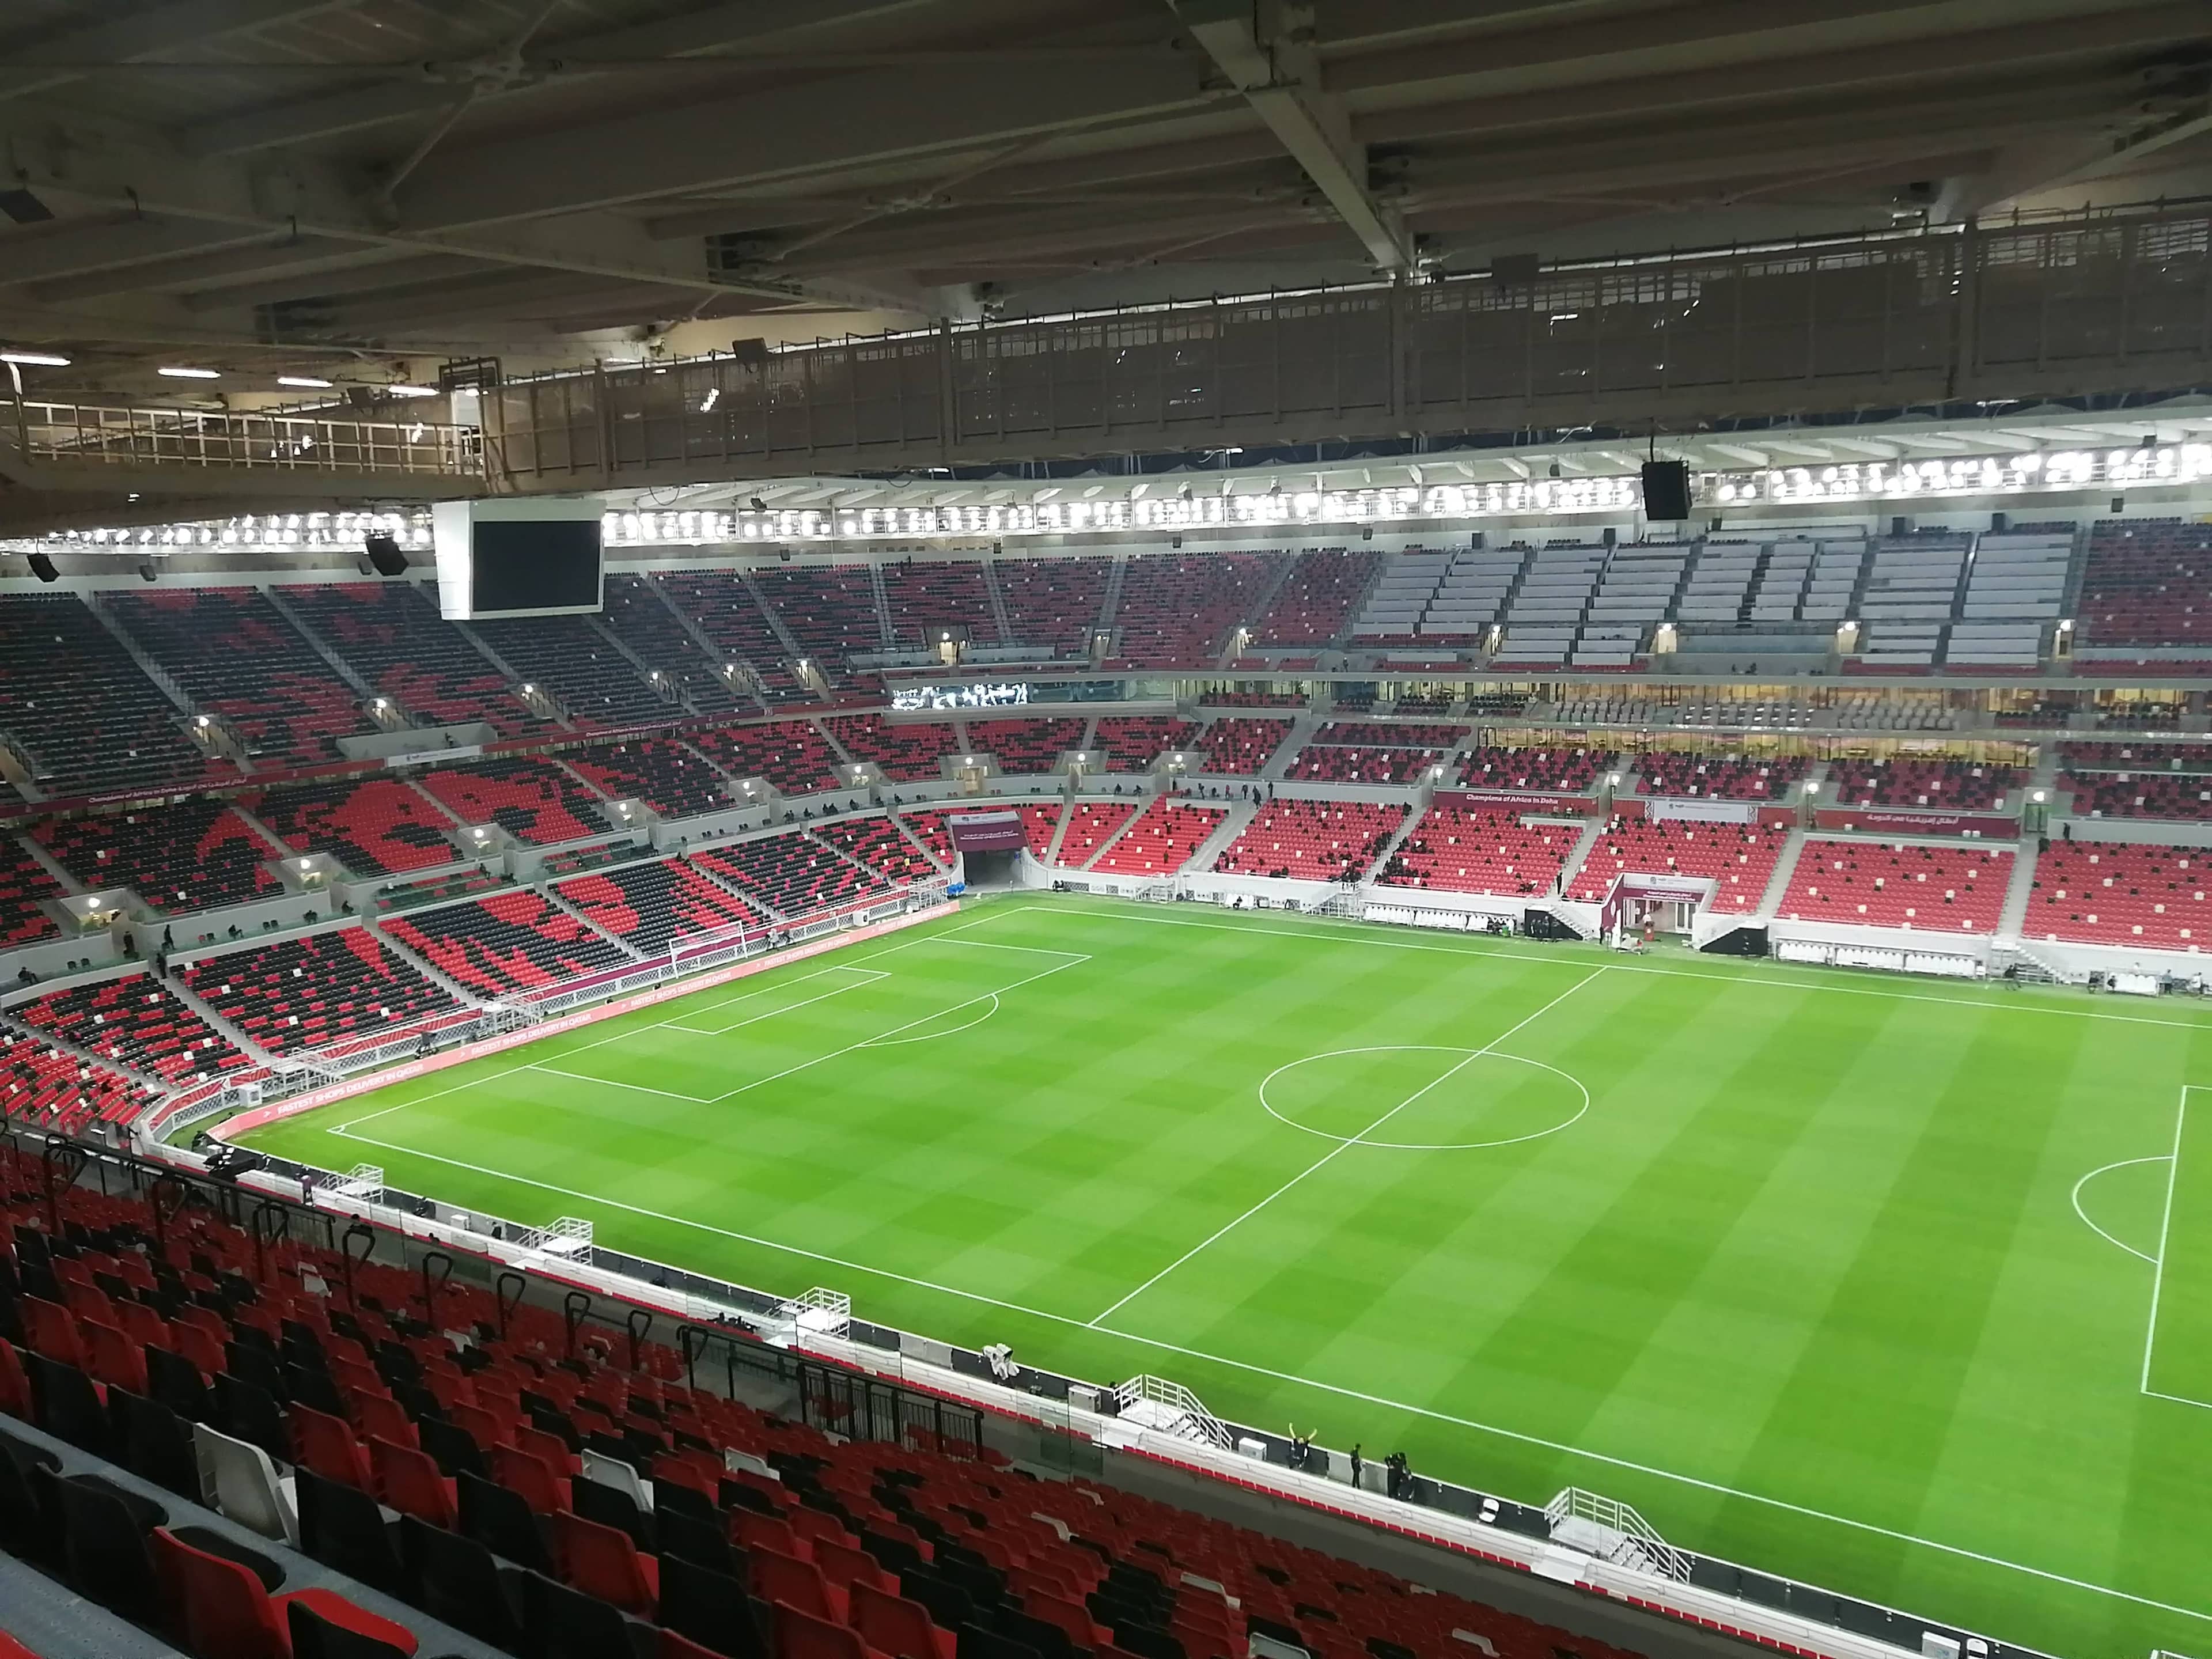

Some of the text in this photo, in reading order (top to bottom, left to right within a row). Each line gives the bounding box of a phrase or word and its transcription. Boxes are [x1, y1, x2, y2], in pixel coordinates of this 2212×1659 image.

[1466, 794, 1502, 802] Champions
[631, 994, 656, 1007] FASTEST
[656, 988, 677, 999] SHOPS
[677, 980, 704, 993] DELIVERY
[713, 972, 731, 983] QATAR
[471, 1040, 501, 1055] FASTEST
[502, 1033, 528, 1046] SHOPS
[529, 1024, 560, 1039] DELIVERY
[569, 1014, 592, 1026] QATAR
[278, 1064, 424, 1115] FASTEST SHOPS DELIVERY IN QATAR
